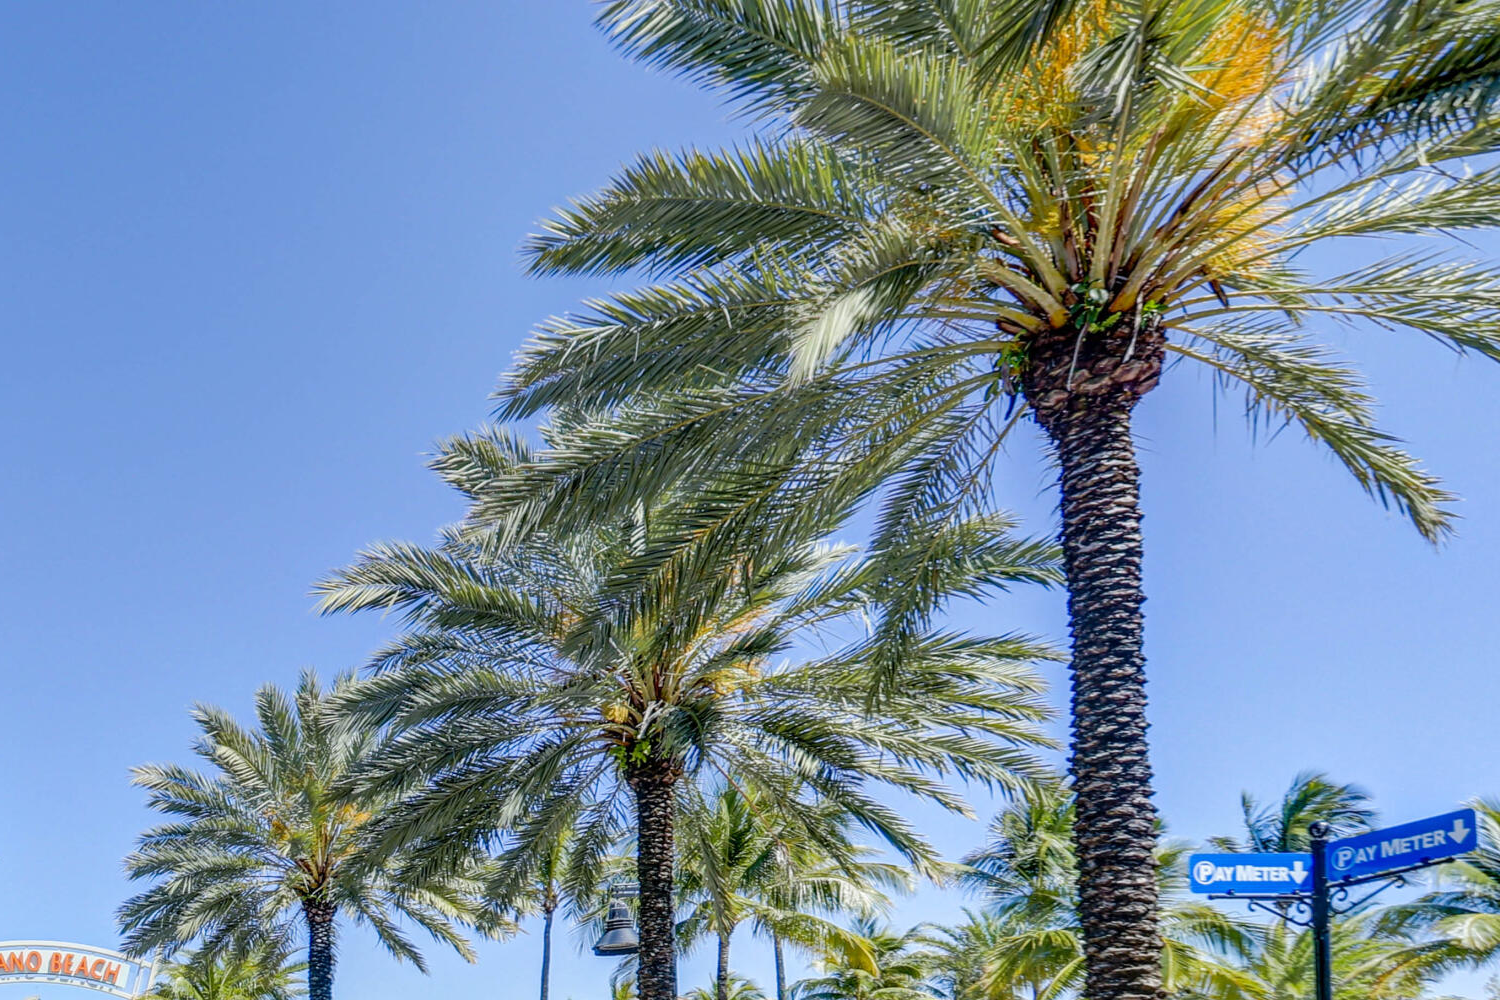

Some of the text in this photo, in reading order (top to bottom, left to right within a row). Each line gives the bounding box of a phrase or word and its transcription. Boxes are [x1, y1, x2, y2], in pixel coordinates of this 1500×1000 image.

[1380, 829, 1447, 858] METER
[1194, 861, 1290, 884] PAY METER
[49, 952, 122, 985] BEACH
